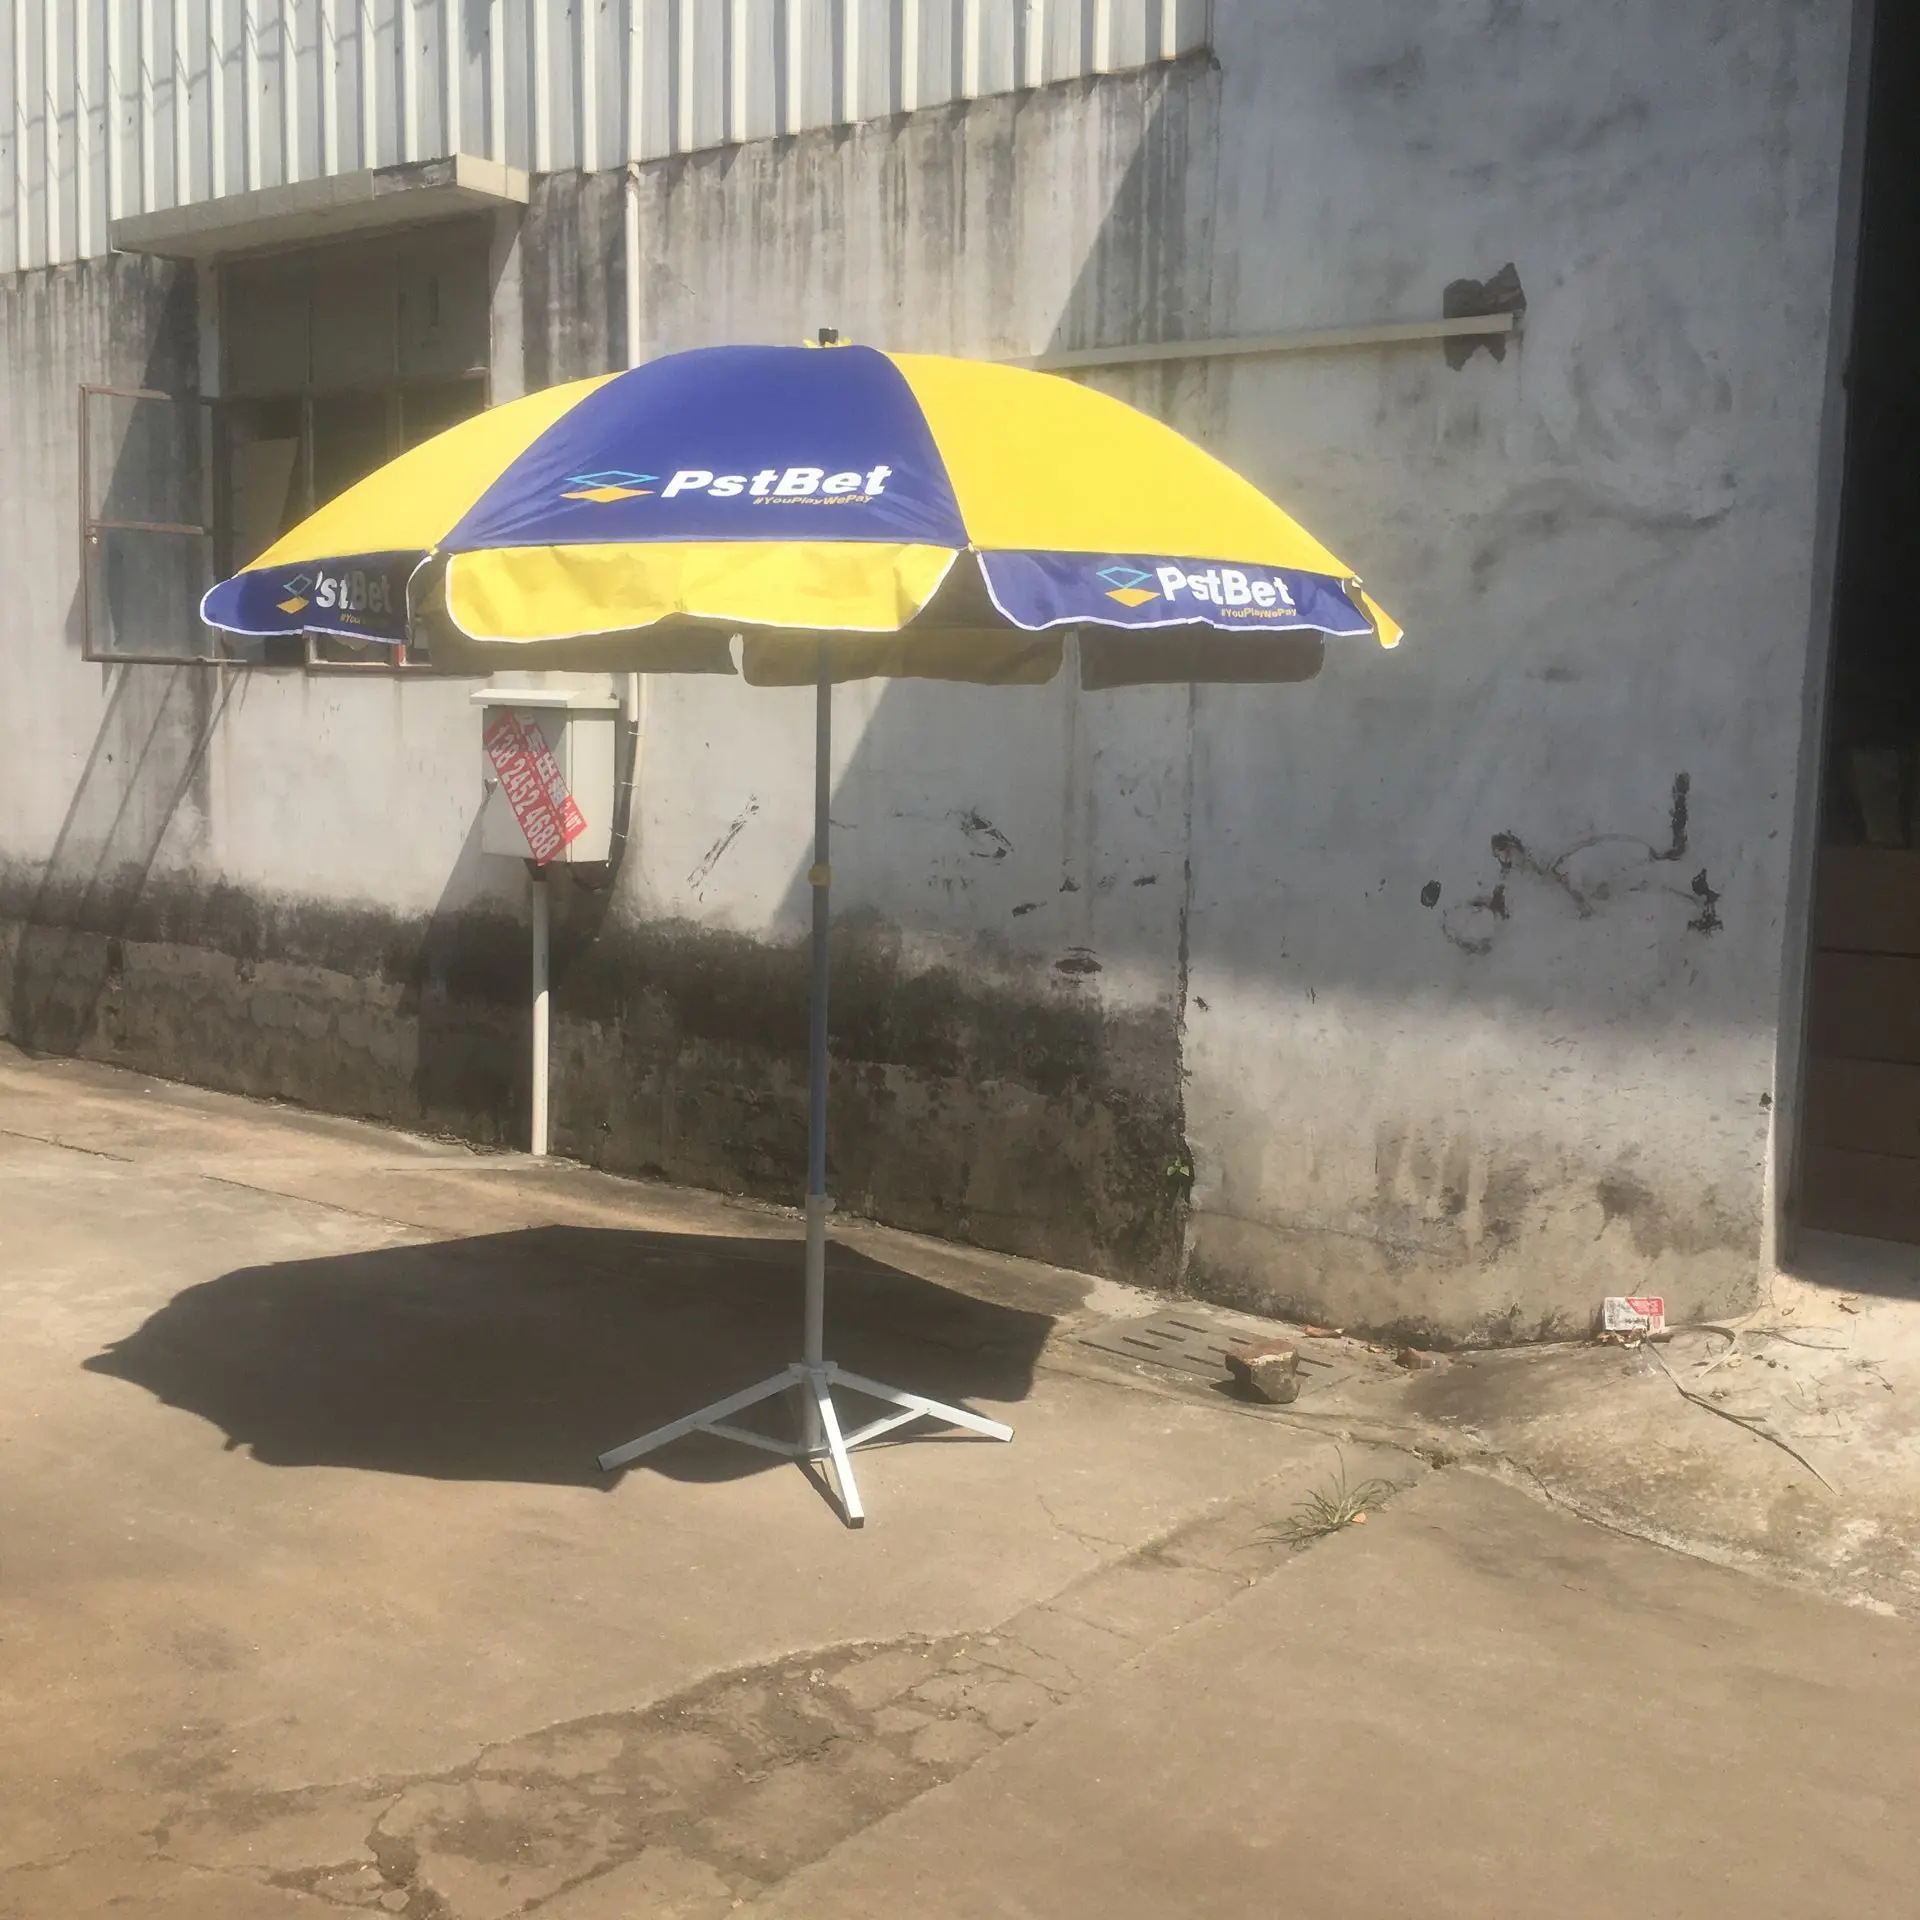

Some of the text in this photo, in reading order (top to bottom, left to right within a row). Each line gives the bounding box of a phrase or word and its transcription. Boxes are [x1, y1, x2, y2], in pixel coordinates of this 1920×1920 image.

[660, 464, 893, 498] PstBet
[752, 493, 873, 506] #YouPlayWePay
[1155, 566, 1296, 607] PstBet
[488, 724, 520, 769] 138
[501, 757, 541, 817] 2452
[523, 805, 562, 860] 4688
